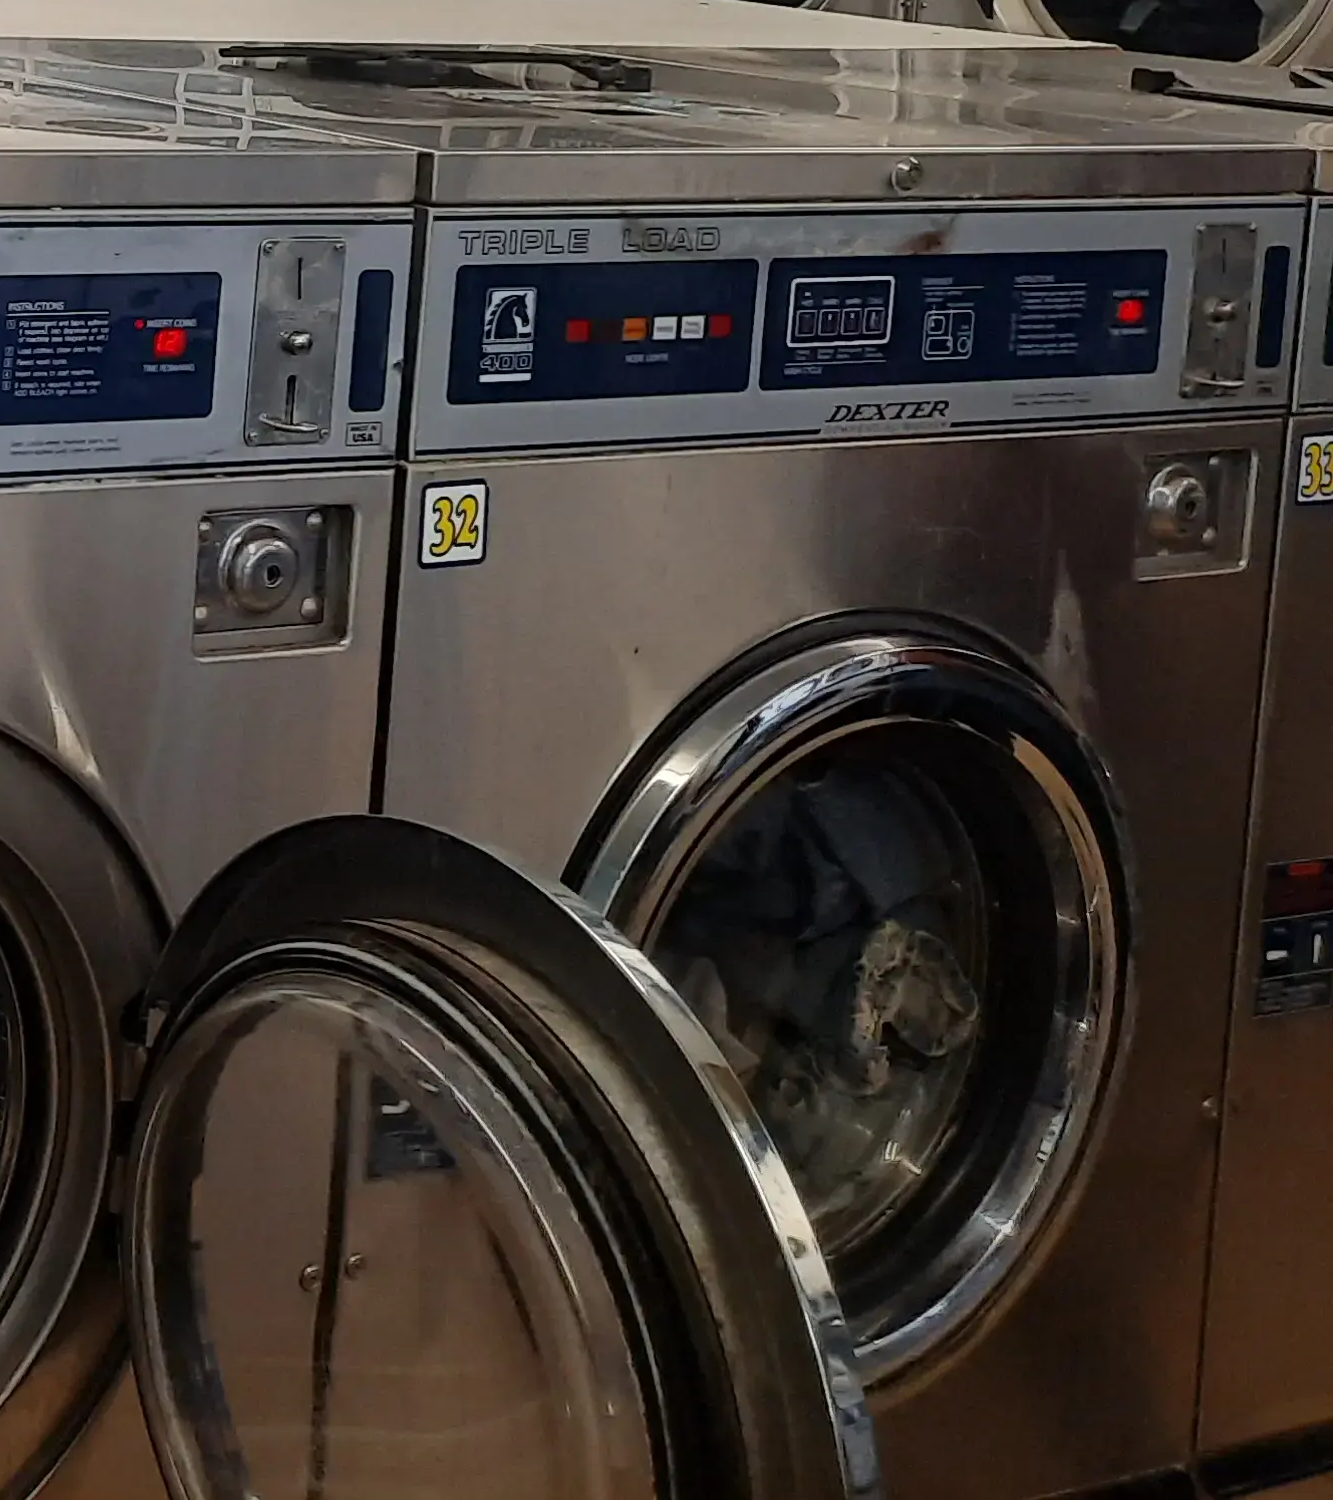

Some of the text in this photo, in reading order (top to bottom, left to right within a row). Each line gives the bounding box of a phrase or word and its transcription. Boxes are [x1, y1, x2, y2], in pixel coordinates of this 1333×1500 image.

[459, 227, 721, 255] TRIPLE LOAD
[480, 352, 532, 371] 400
[825, 400, 950, 423] DEXTER
[353, 433, 374, 443] USA
[430, 494, 479, 557] 32
